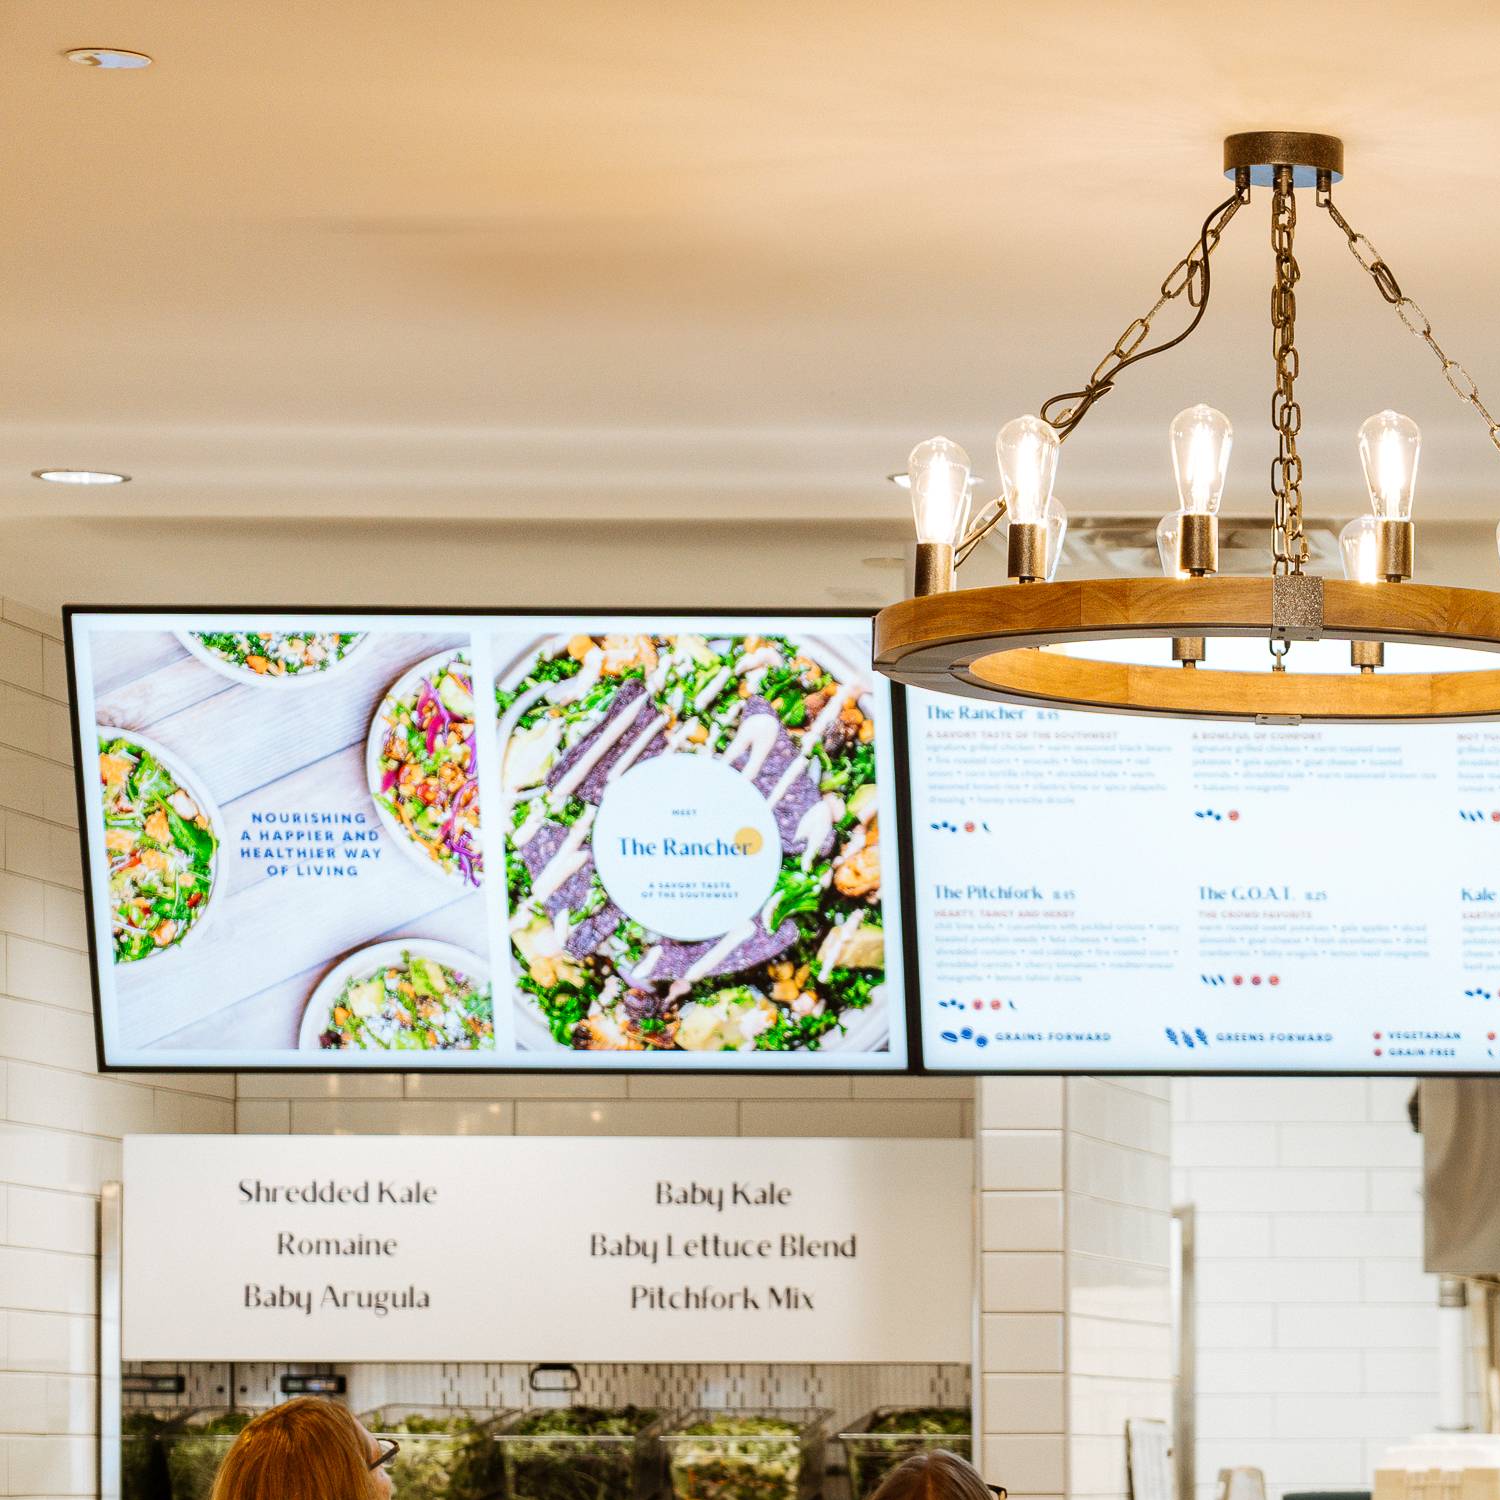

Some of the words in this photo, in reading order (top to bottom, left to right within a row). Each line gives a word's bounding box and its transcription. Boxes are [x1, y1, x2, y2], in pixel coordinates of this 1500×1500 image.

[925, 704, 952, 721] The
[958, 704, 1025, 721] Rancher
[251, 812, 367, 825] NOURISHING
[240, 830, 252, 841] A
[259, 830, 335, 842] HAPPIER
[341, 830, 380, 842] AND
[240, 847, 336, 859] HEALTHIER
[344, 848, 381, 859] WAY
[618, 837, 656, 855] The
[663, 837, 752, 855] Rancher
[266, 864, 289, 878] OF
[296, 864, 358, 877] LIVING
[935, 884, 963, 900] The
[966, 884, 1044, 900] Pitchfork
[1199, 885, 1227, 901] The
[1460, 887, 1497, 903] Kale
[1047, 1032, 1112, 1042] FORWARD
[1215, 1032, 1265, 1043] GREENS
[1269, 1032, 1333, 1043] FORWARD
[1388, 1031, 1462, 1041] VEGETARIAN
[238, 1180, 370, 1204] Shredded
[379, 1180, 438, 1204] Kale
[656, 1181, 724, 1211] Baby
[732, 1182, 792, 1205] Kale
[278, 1233, 397, 1256] Romaine
[590, 1233, 658, 1263] Baby
[667, 1233, 772, 1259] Lettuce
[780, 1233, 857, 1259] Blend
[244, 1284, 312, 1315] Baby
[320, 1284, 430, 1315] Arugula
[631, 1285, 760, 1310] Pitchfork
[769, 1285, 815, 1310] Mix
